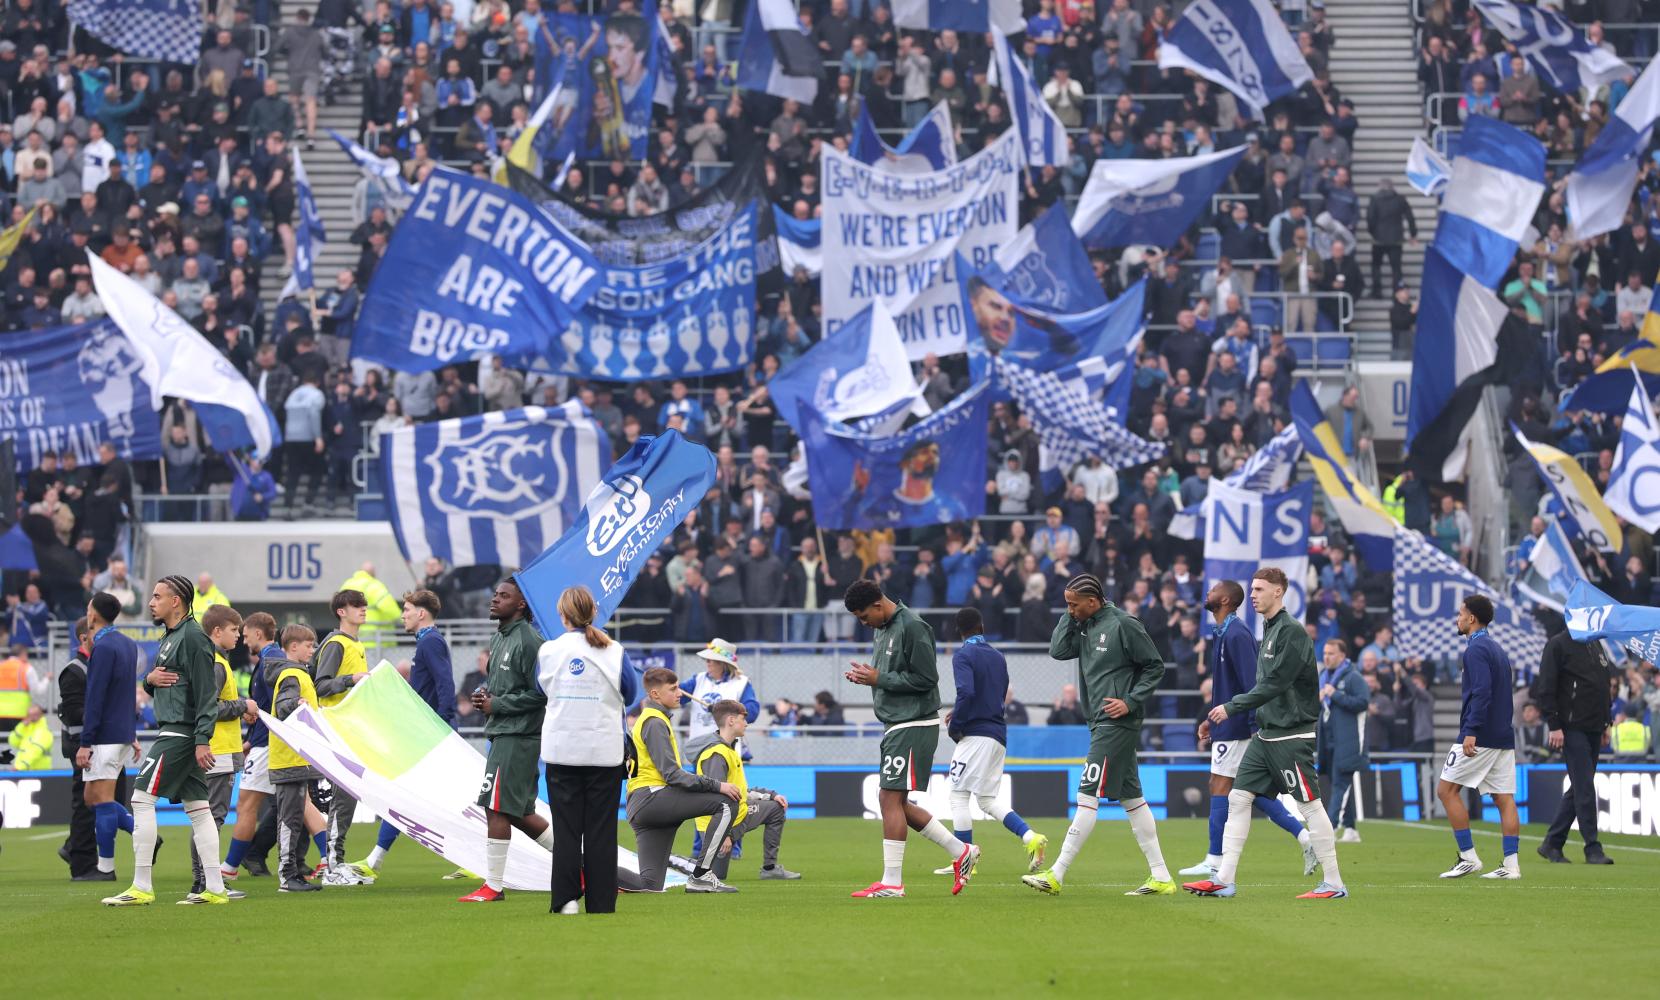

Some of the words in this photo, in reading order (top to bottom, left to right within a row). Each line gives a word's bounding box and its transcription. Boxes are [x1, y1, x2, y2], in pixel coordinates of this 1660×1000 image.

[840, 211, 909, 248] WE'RE
[918, 191, 1007, 245] EVERTON
[414, 176, 597, 304] EVERTON
[437, 254, 524, 317] ARE
[588, 286, 666, 311] SON
[672, 257, 753, 301] GANG
[851, 264, 897, 298] AND
[20, 396, 46, 427] OF
[28, 421, 101, 470] DEAN
[268, 543, 323, 580] 005
[882, 755, 906, 776] 29
[950, 759, 967, 777] 27
[1216, 743, 1228, 758] 9
[1080, 762, 1101, 783] 20
[1562, 772, 1660, 837] CIEN
